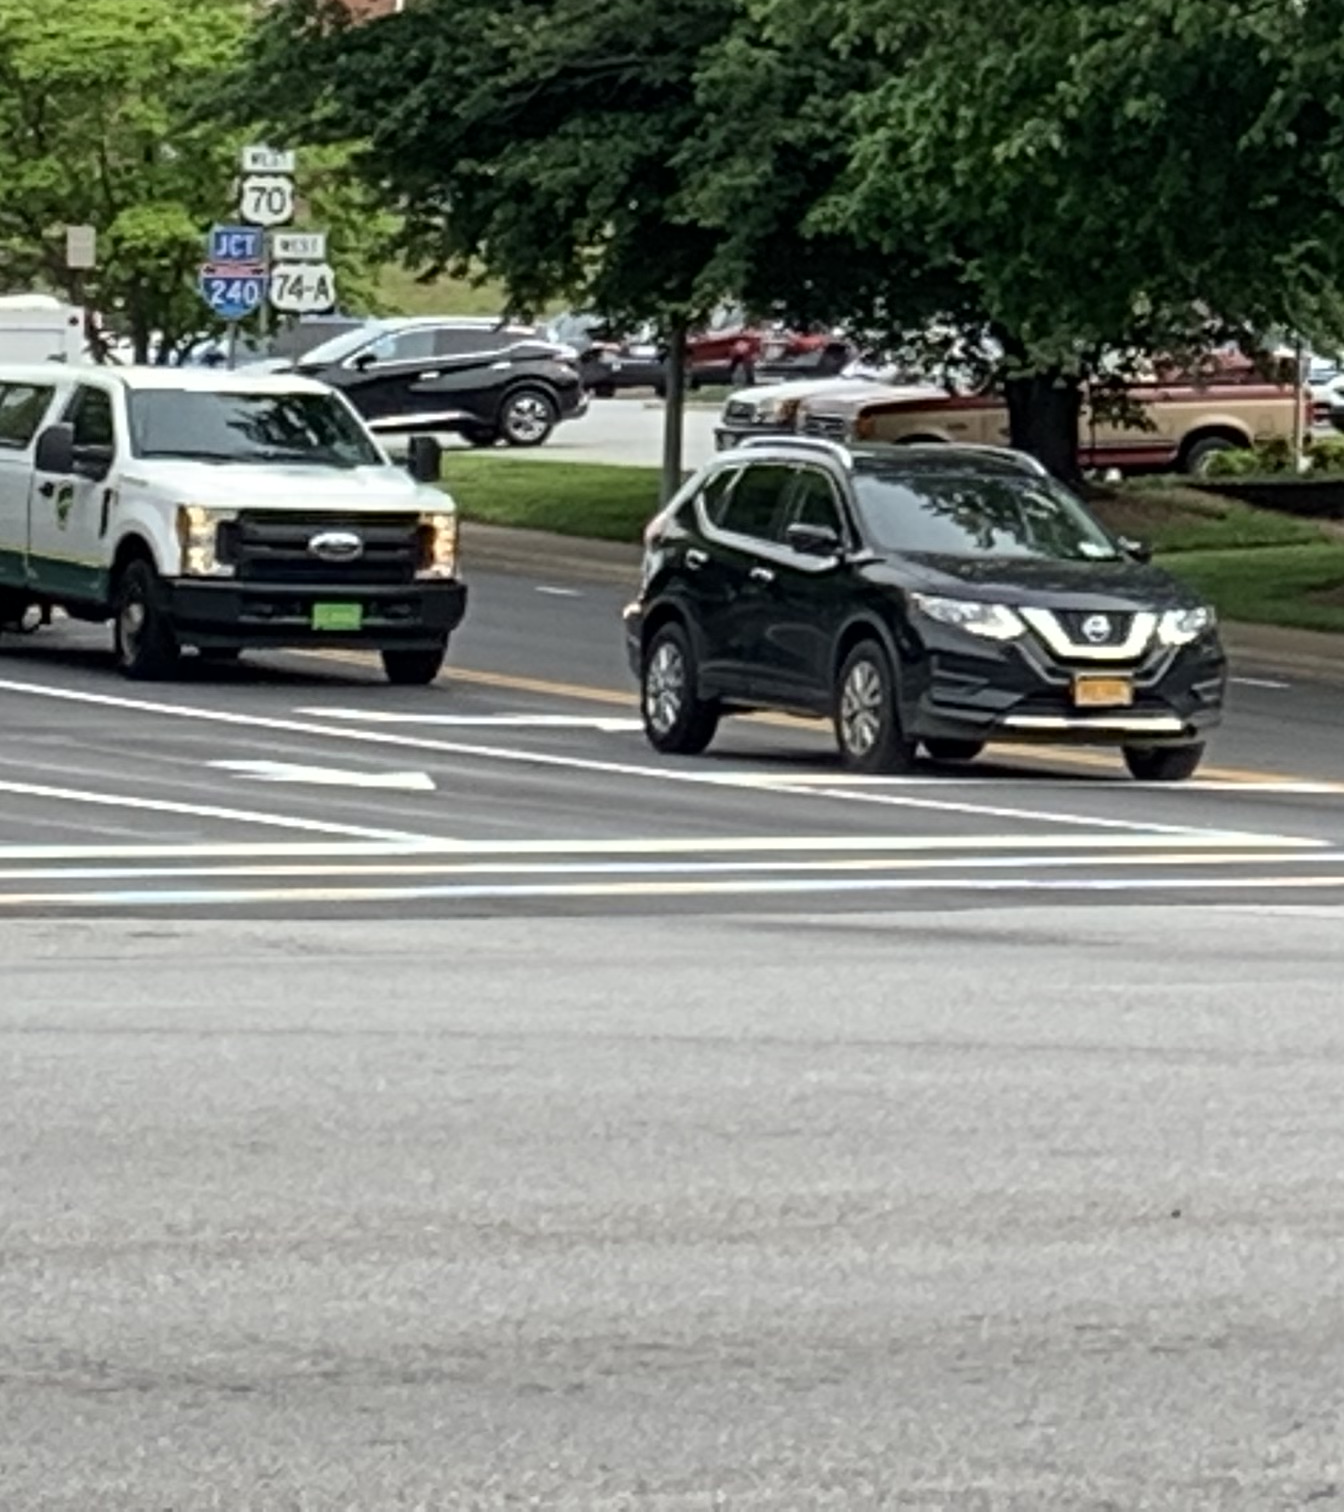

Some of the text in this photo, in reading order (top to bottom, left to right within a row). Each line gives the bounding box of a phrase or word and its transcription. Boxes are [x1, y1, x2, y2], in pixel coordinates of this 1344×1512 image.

[248, 186, 287, 215] 70
[216, 234, 256, 257] JCT
[210, 280, 259, 305] 240
[276, 274, 330, 302] 74-A
